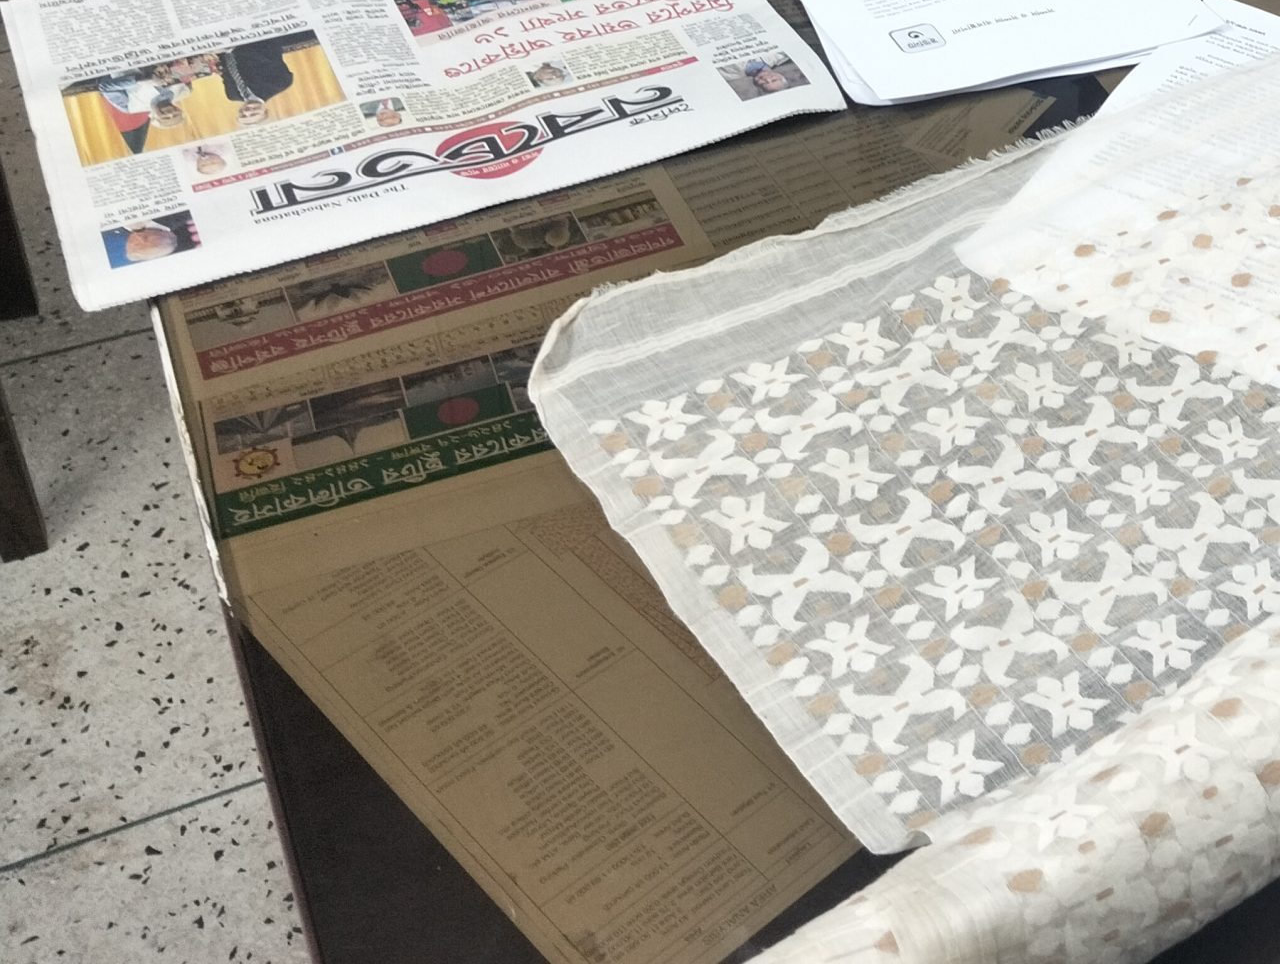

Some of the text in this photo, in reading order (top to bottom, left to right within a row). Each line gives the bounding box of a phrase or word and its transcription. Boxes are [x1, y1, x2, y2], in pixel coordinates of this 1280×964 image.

[470, 25, 511, 45] ১৬
[515, 6, 588, 32] সংখ্যা
[555, 14, 641, 45] ভয়াবহ
[435, 34, 558, 78] অগ্নিকাণ্ডে
[624, 102, 692, 126] দৈনিক
[250, 86, 685, 216] নবচেতনা
[344, 188, 380, 205] Daily
[565, 234, 676, 275] গণপ্রজাতন্ত্রী
[468, 265, 560, 301] বাংলাদেশ
[369, 292, 465, 329] সরকারের
[289, 318, 362, 355] ছুটিসহ
[226, 425, 548, 531] রকারের ছুটির তালিকাসহ
